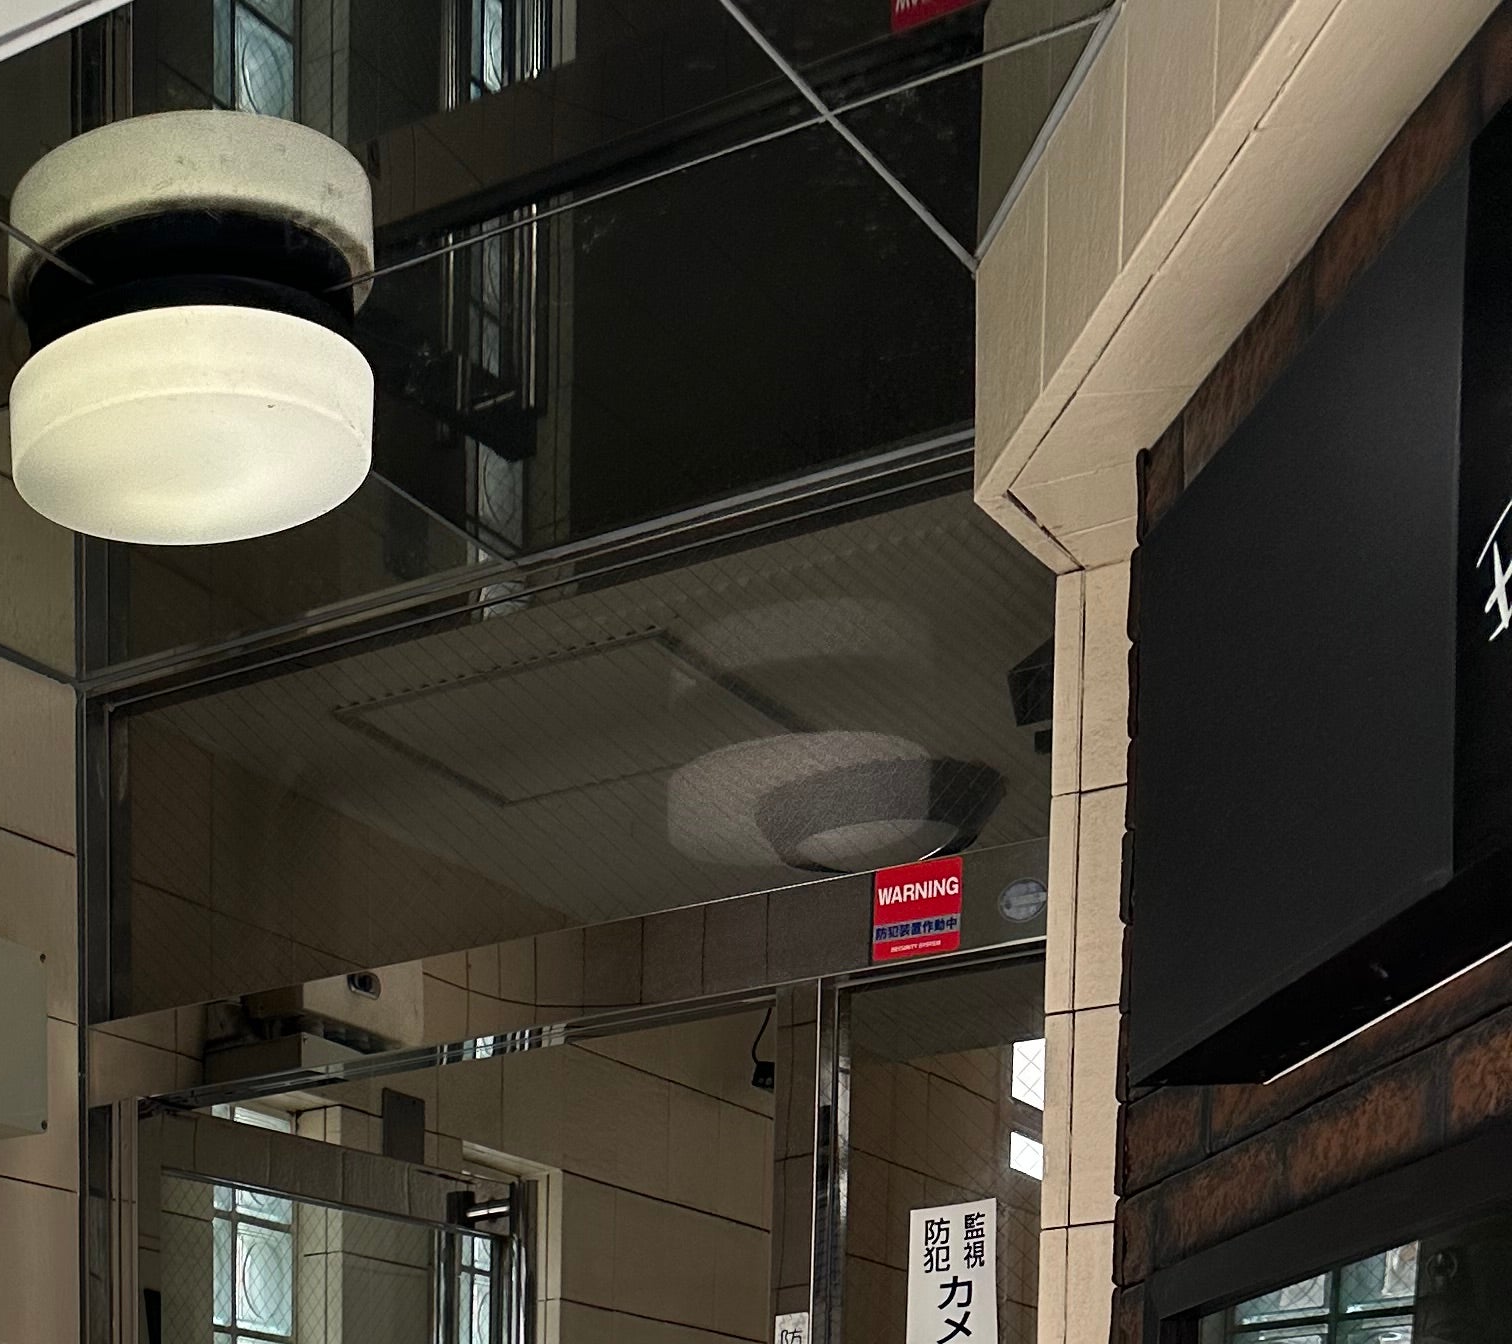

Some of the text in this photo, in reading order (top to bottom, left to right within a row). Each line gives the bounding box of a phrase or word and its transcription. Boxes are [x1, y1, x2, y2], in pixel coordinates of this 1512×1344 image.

[878, 876, 959, 906] WARNING
[924, 1217, 951, 1273] 防犯
[964, 1211, 986, 1269] 監視
